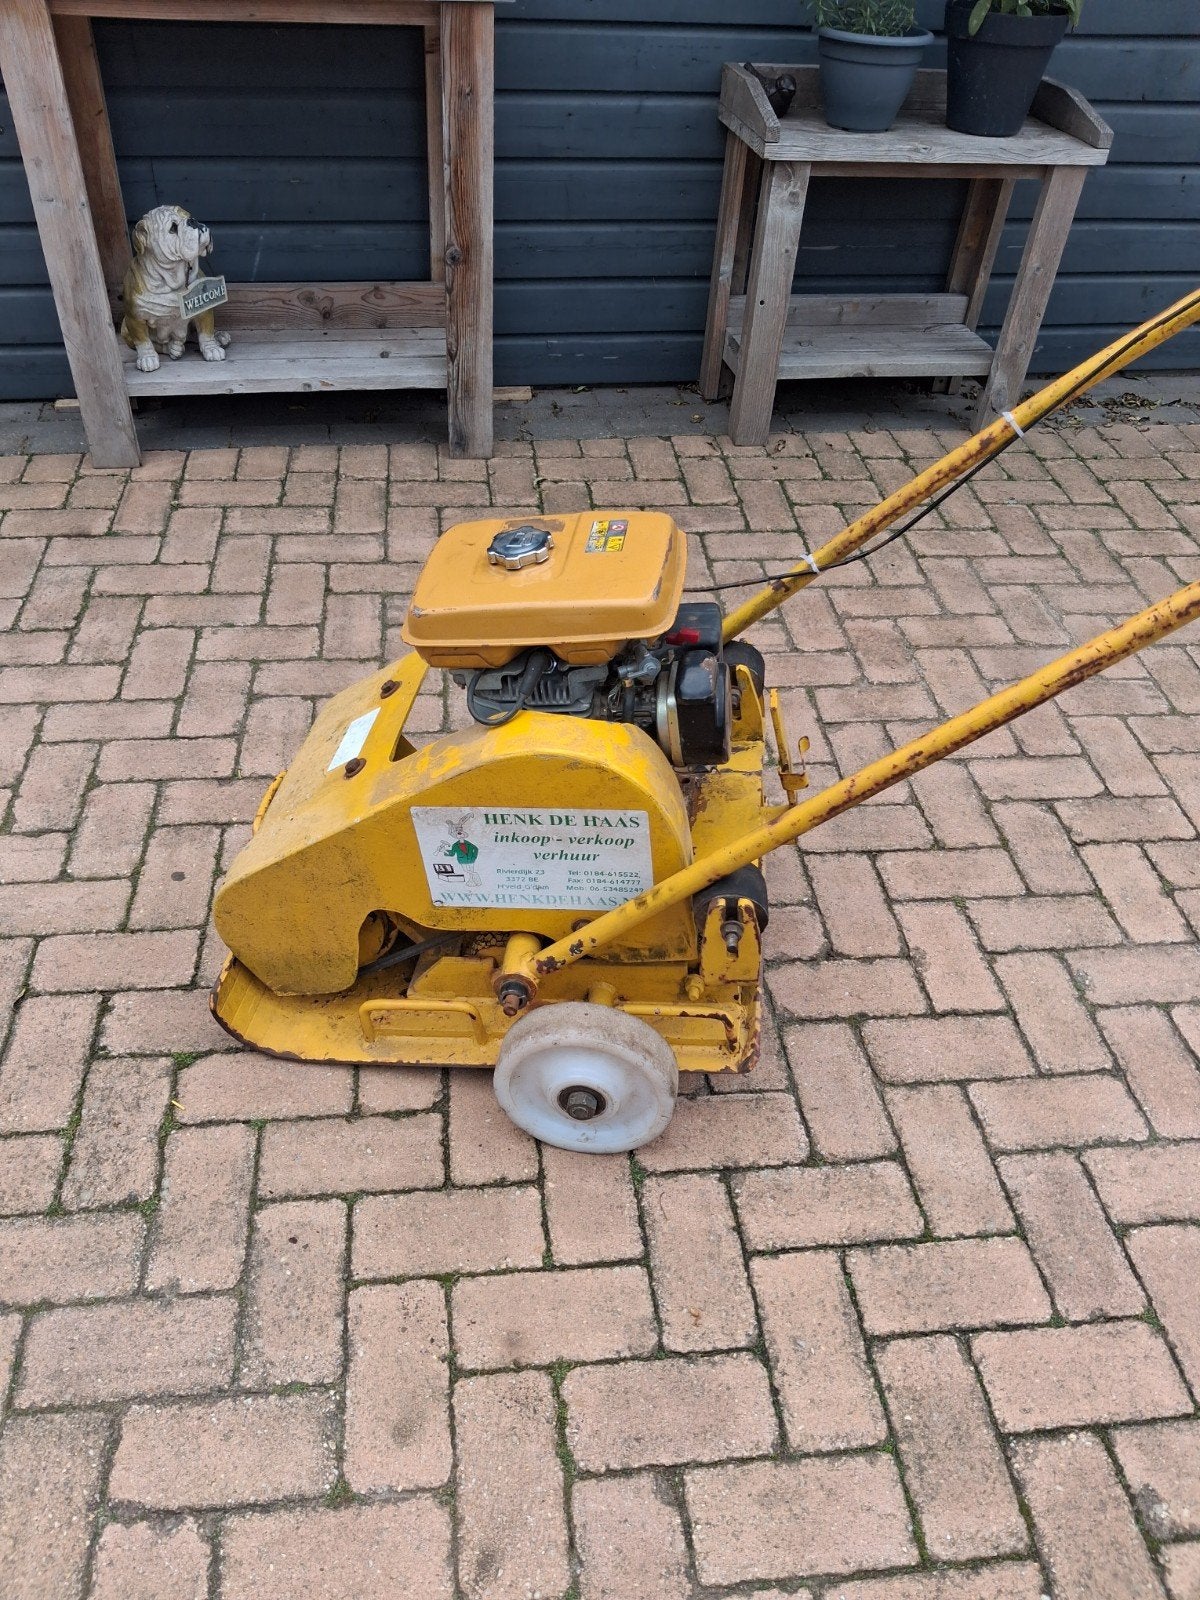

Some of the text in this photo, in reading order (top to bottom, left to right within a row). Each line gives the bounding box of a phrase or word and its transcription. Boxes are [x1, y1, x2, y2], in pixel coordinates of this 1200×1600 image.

[184, 285, 225, 310] WELCOME
[484, 813, 640, 828] HENK DE HAAS
[494, 831, 550, 847] inkoop
[568, 834, 635, 849] verkoop
[533, 850, 600, 862] verhuur
[496, 868, 533, 876] Rivierdijk
[440, 892, 629, 907] WWW.HENKDEHAAS.
